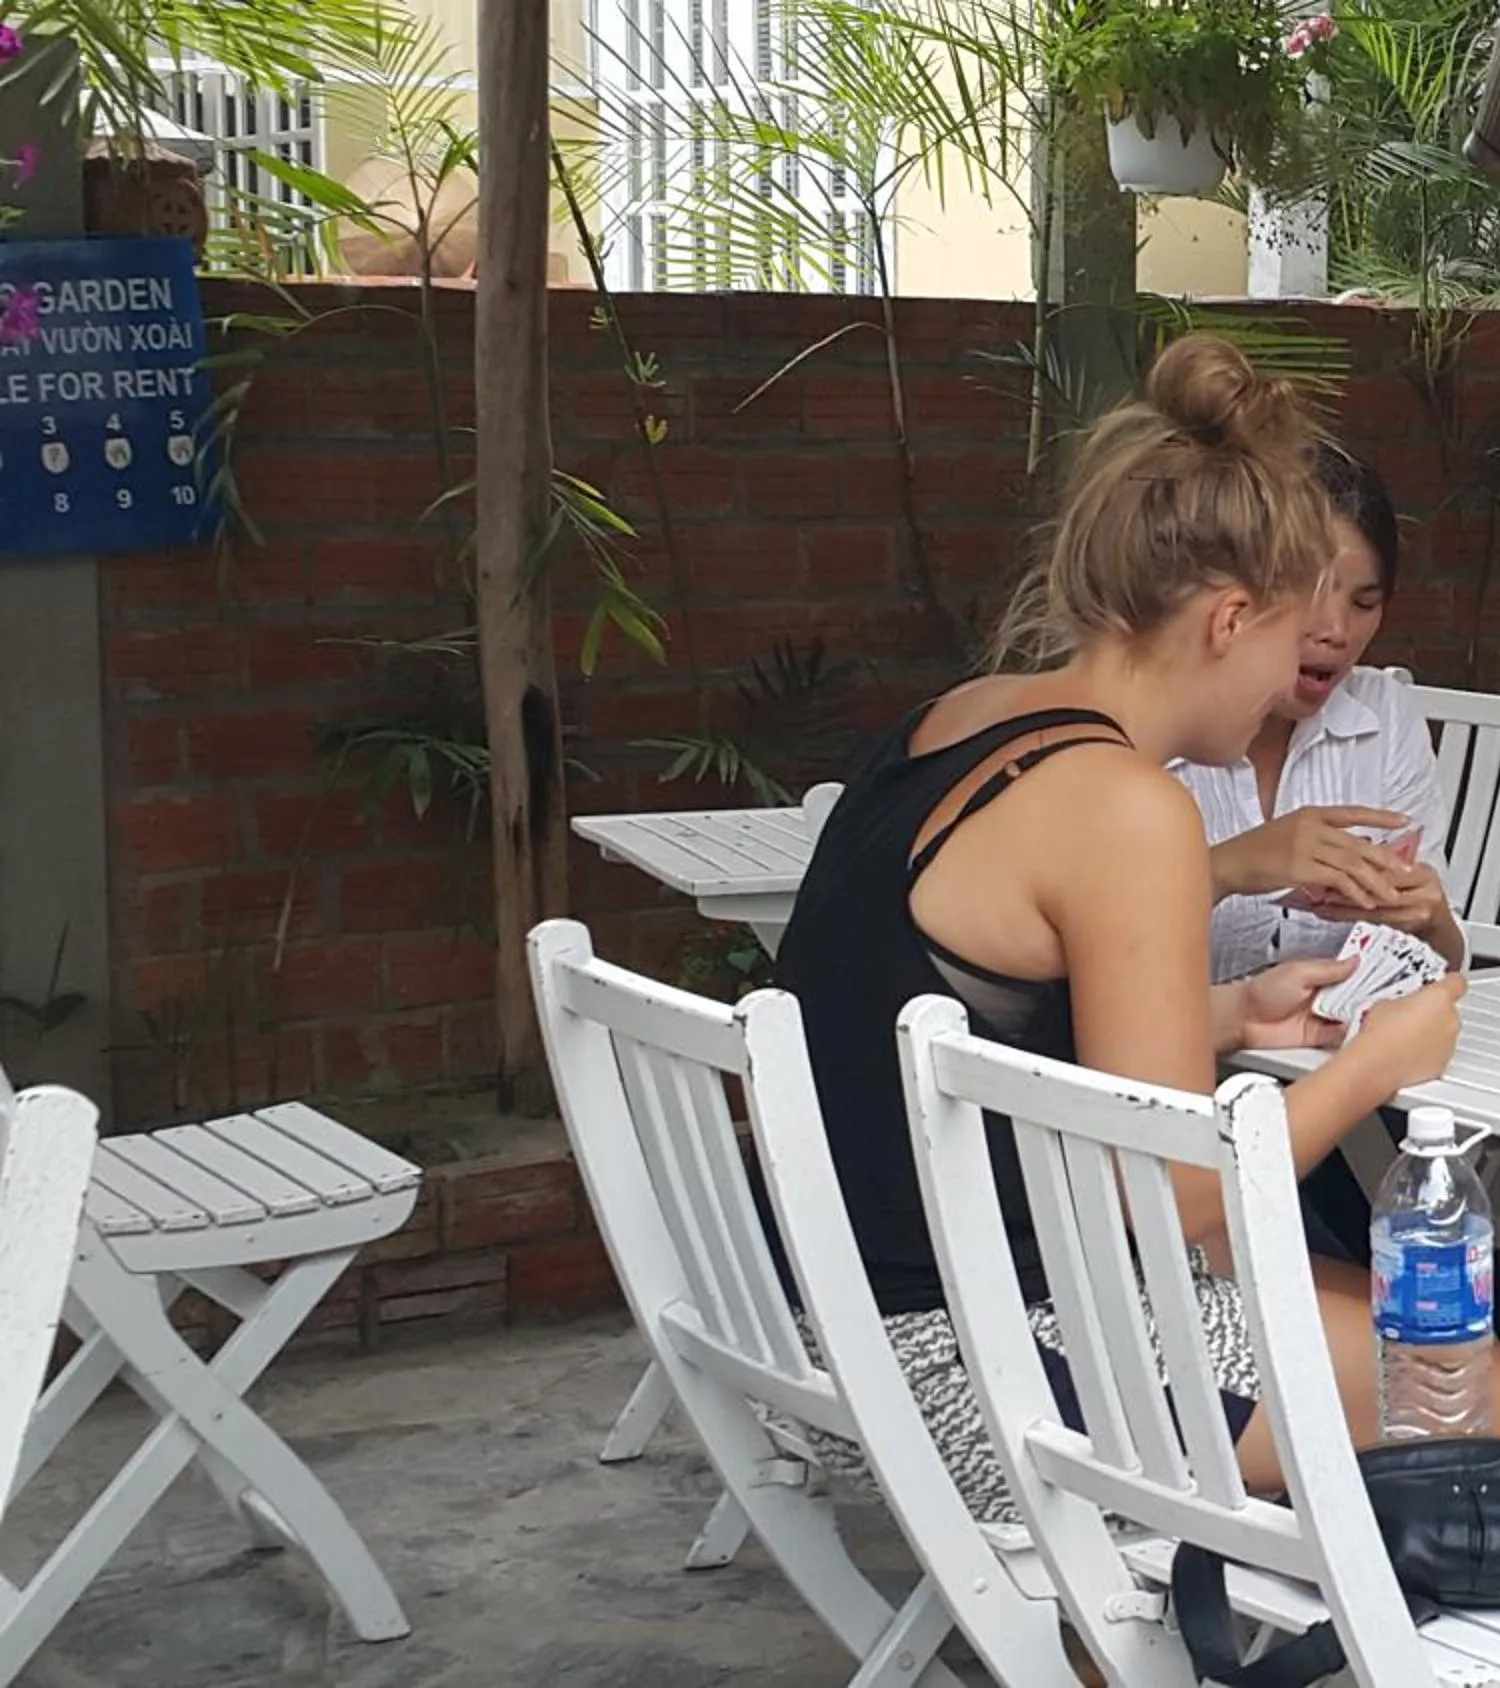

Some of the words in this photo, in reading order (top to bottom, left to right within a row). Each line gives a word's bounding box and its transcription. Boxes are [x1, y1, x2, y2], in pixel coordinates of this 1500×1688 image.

[32, 277, 173, 314] GARDEN
[41, 320, 123, 356] VƯỜN
[128, 316, 193, 351] XOÀI
[37, 372, 106, 403] FOR
[112, 367, 196, 399] RENT
[41, 415, 57, 435] 3
[105, 412, 122, 432] 4
[169, 410, 186, 429] 5
[53, 492, 71, 513] 8
[116, 488, 133, 509] 9
[170, 484, 196, 505] 10
